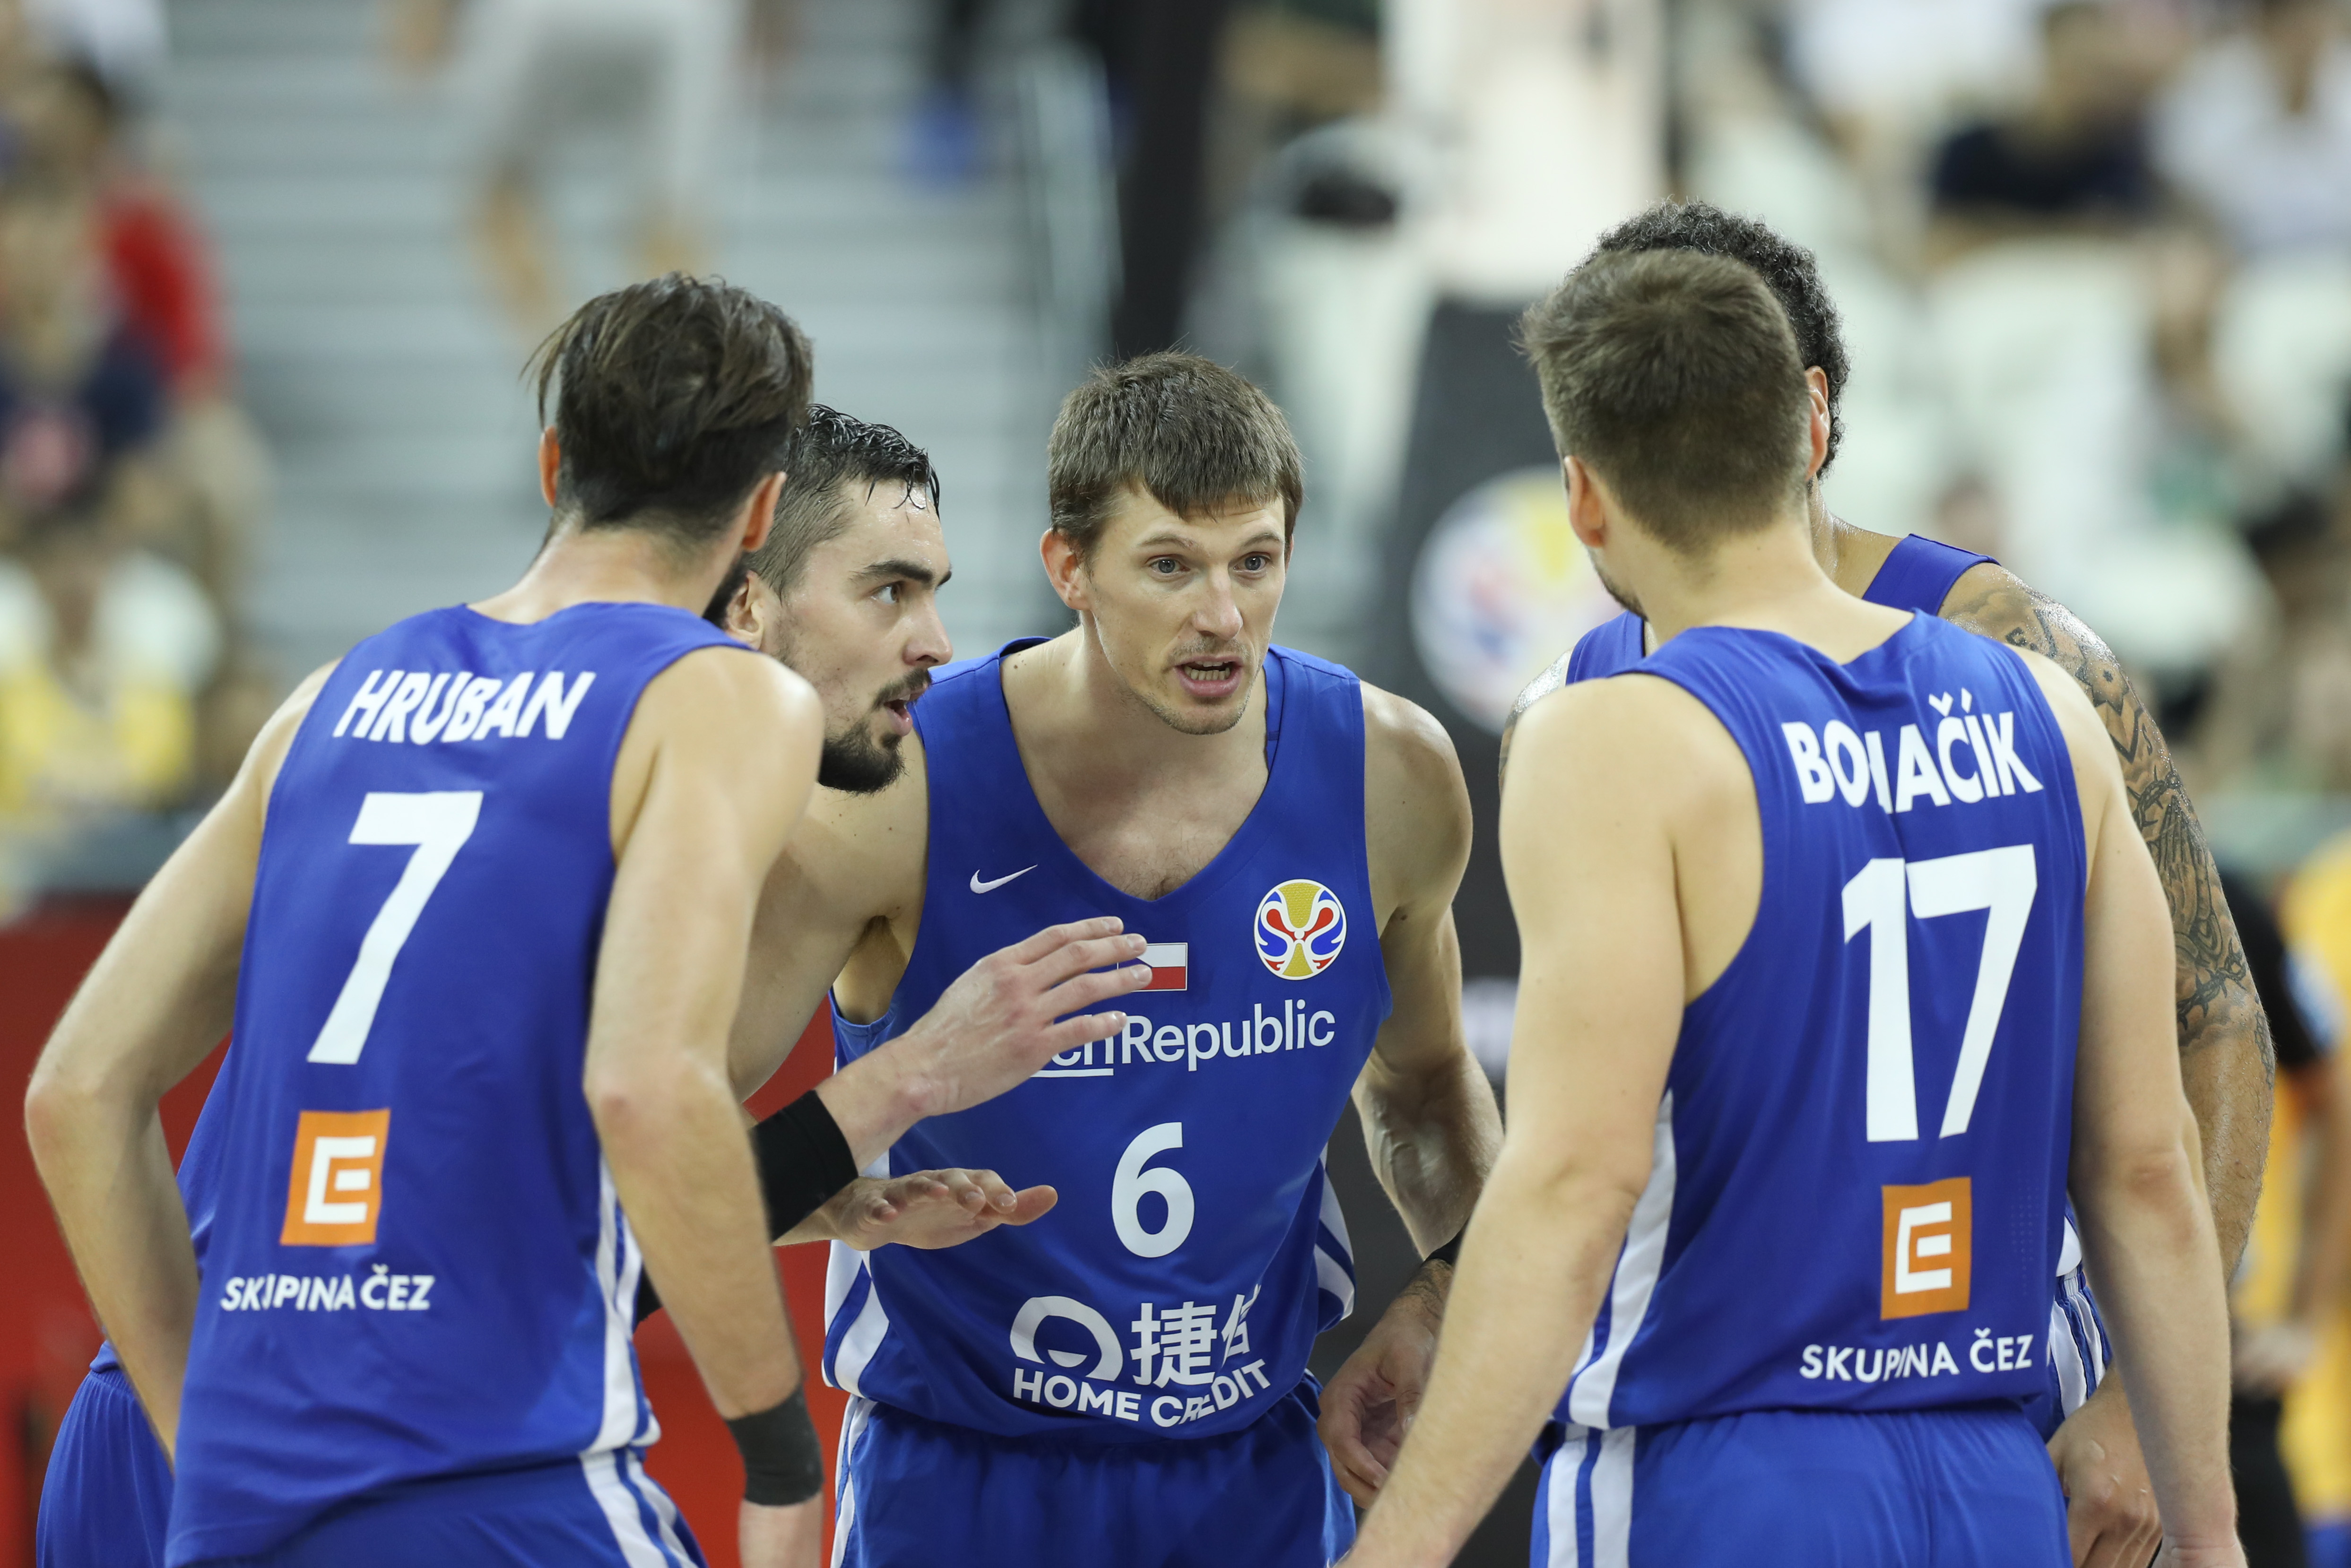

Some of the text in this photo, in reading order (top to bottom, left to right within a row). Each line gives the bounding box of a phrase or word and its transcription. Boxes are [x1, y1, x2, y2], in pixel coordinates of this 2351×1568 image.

[332, 669, 597, 745] HRUBAN
[307, 790, 484, 1065] 7
[1841, 843, 2038, 1143] 17
[1111, 1121, 1195, 1258] 6
[360, 1263, 435, 1311] ČEZ
[1013, 1358, 1271, 1428] HOME CREDIT
[1799, 1327, 2033, 1383] SKUPINA ČEZ
